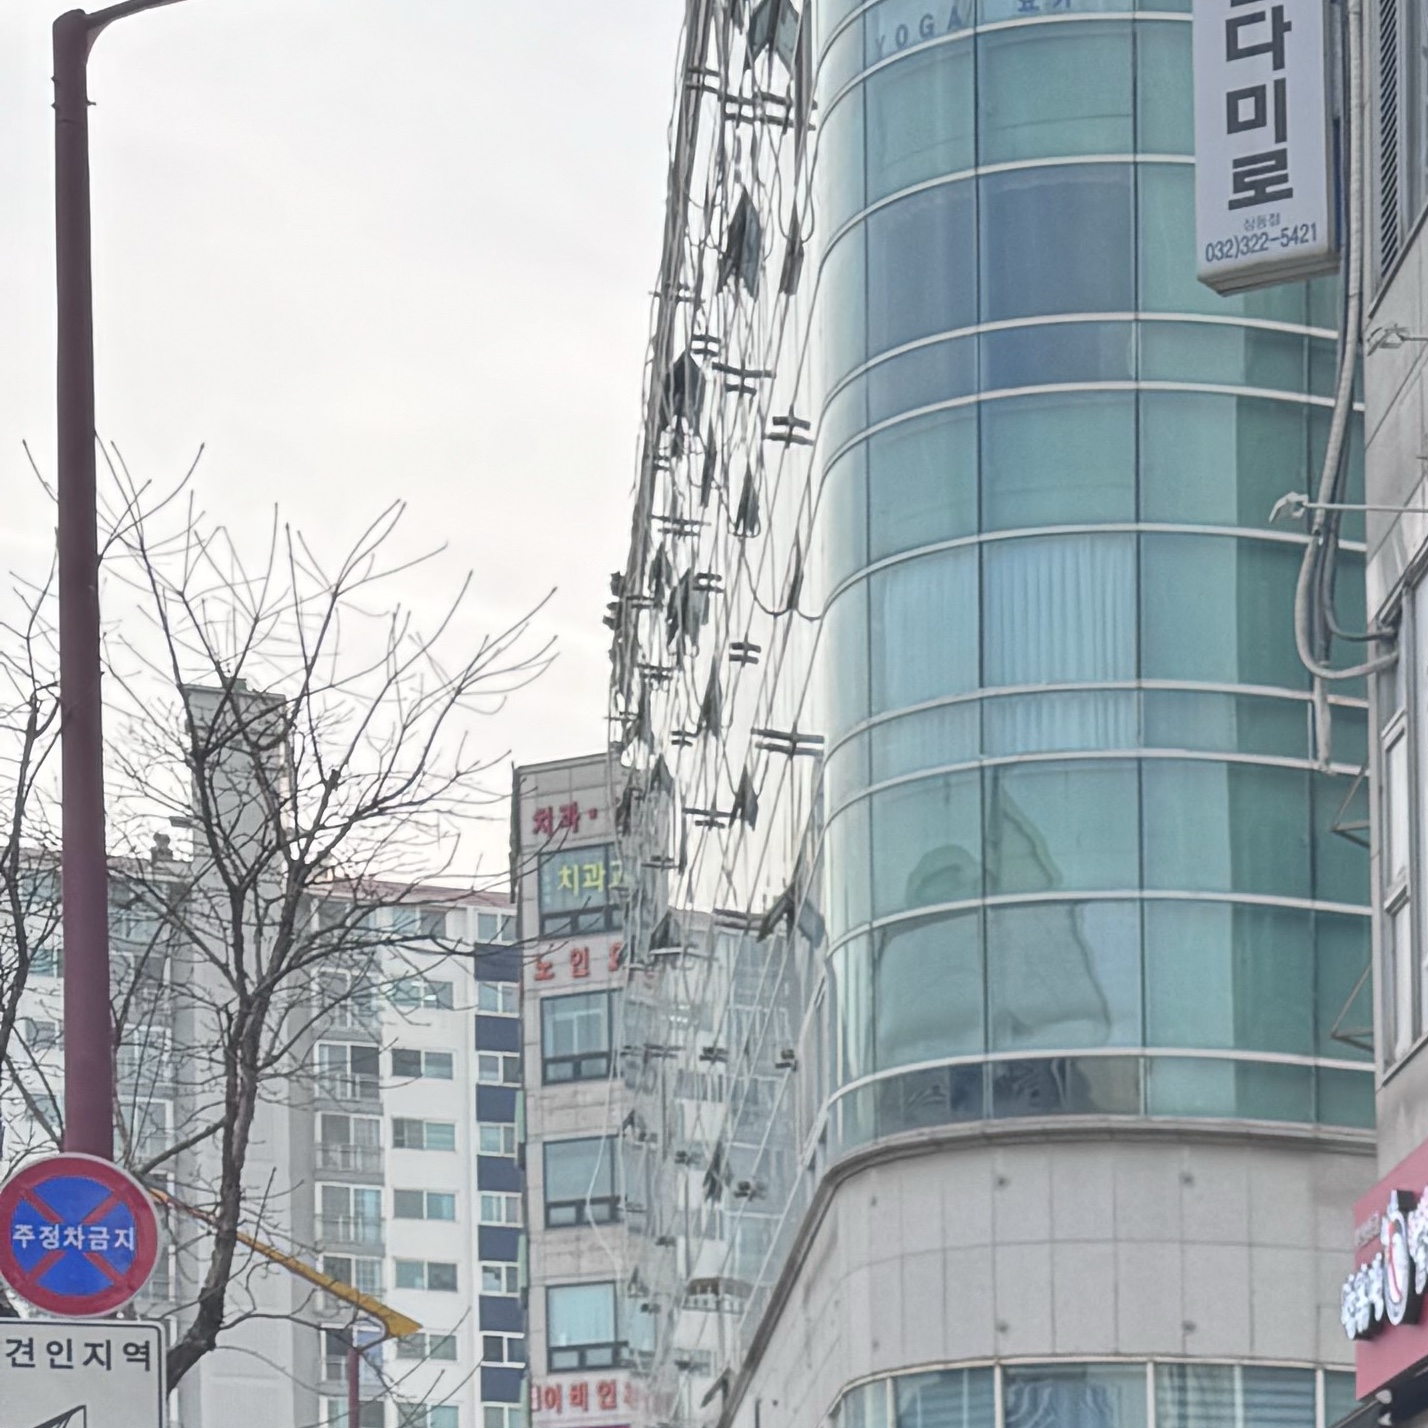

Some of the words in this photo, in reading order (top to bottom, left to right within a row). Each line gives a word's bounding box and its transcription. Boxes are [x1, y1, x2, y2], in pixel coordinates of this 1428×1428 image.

[1225, 0, 1293, 211] 다미로
[1205, 222, 1317, 262] 032)322-5421
[12, 1224, 135, 1250] 주정차금지
[5, 1337, 151, 1371] 견인지역
